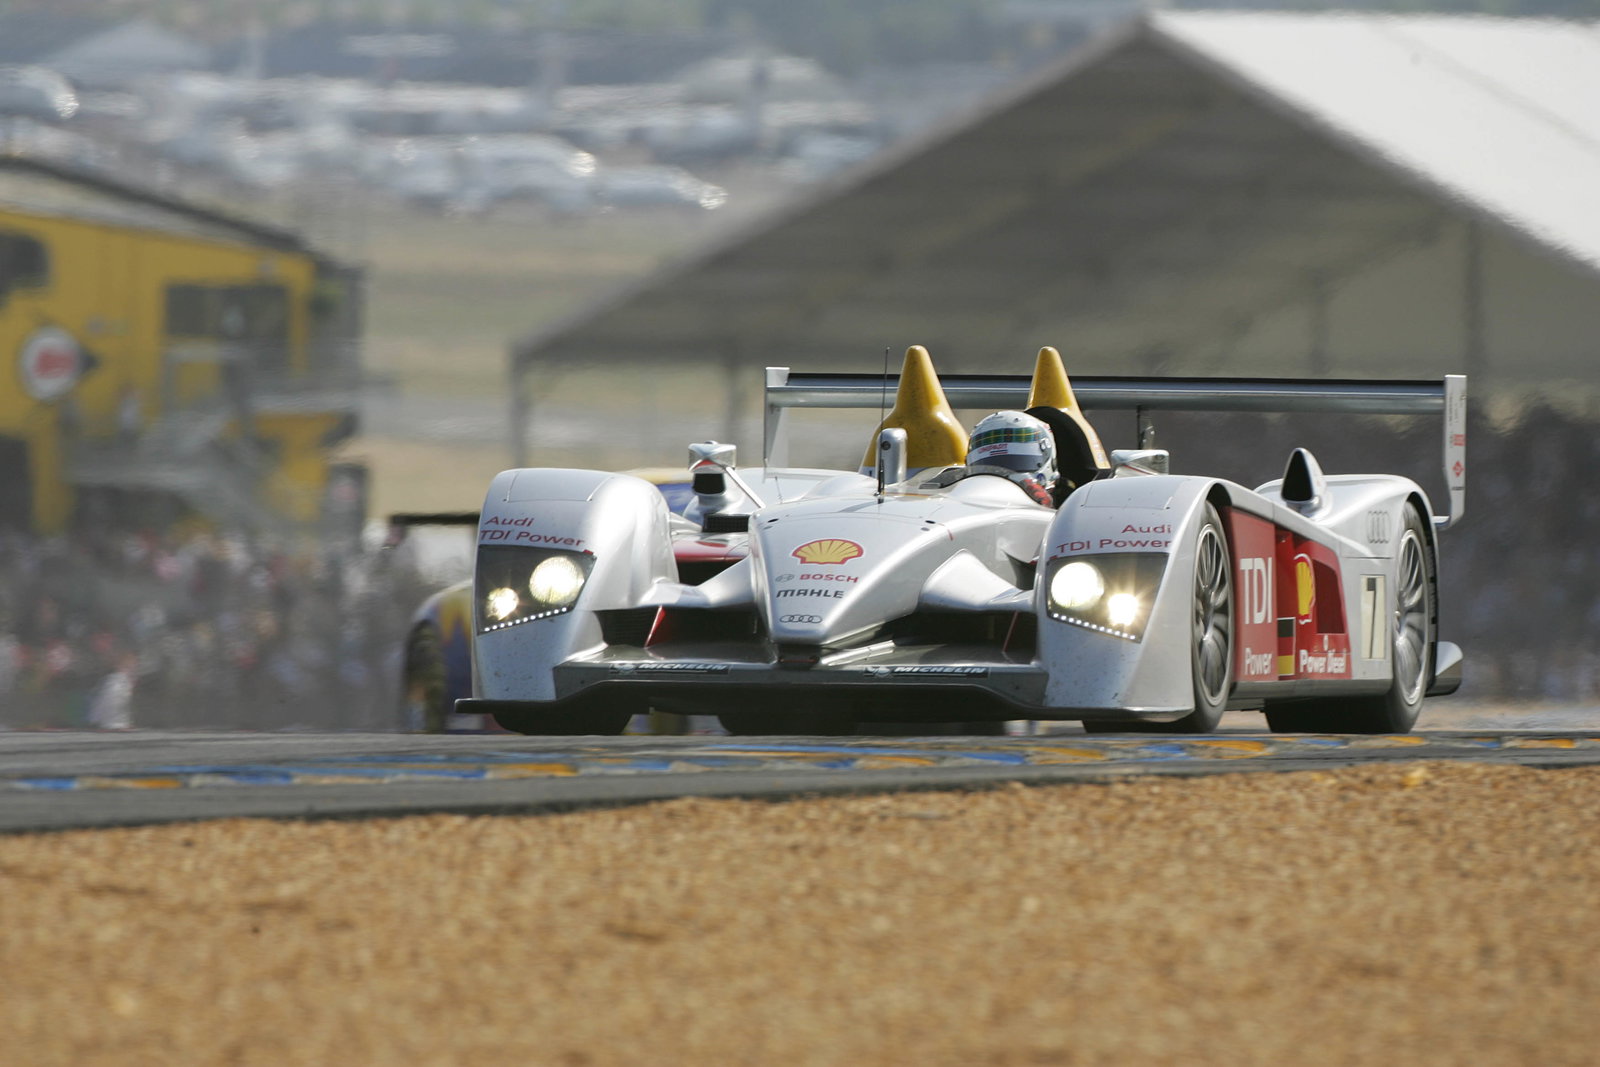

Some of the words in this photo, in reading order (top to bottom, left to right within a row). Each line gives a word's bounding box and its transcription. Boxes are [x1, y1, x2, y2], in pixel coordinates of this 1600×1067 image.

[485, 515, 534, 528] Audi
[1121, 524, 1172, 534] Audi
[480, 529, 511, 541] TDI
[516, 531, 585, 547] Power
[1056, 540, 1091, 553] TDI
[1100, 538, 1171, 549] Power
[800, 573, 859, 583] BOSCH
[776, 588, 844, 599] MAHLE
[1239, 556, 1273, 625] TDI
[639, 662, 727, 671] MICHELIN
[1244, 647, 1272, 675] Power
[1299, 648, 1326, 674] Power
[894, 666, 986, 674] MICHELIN
